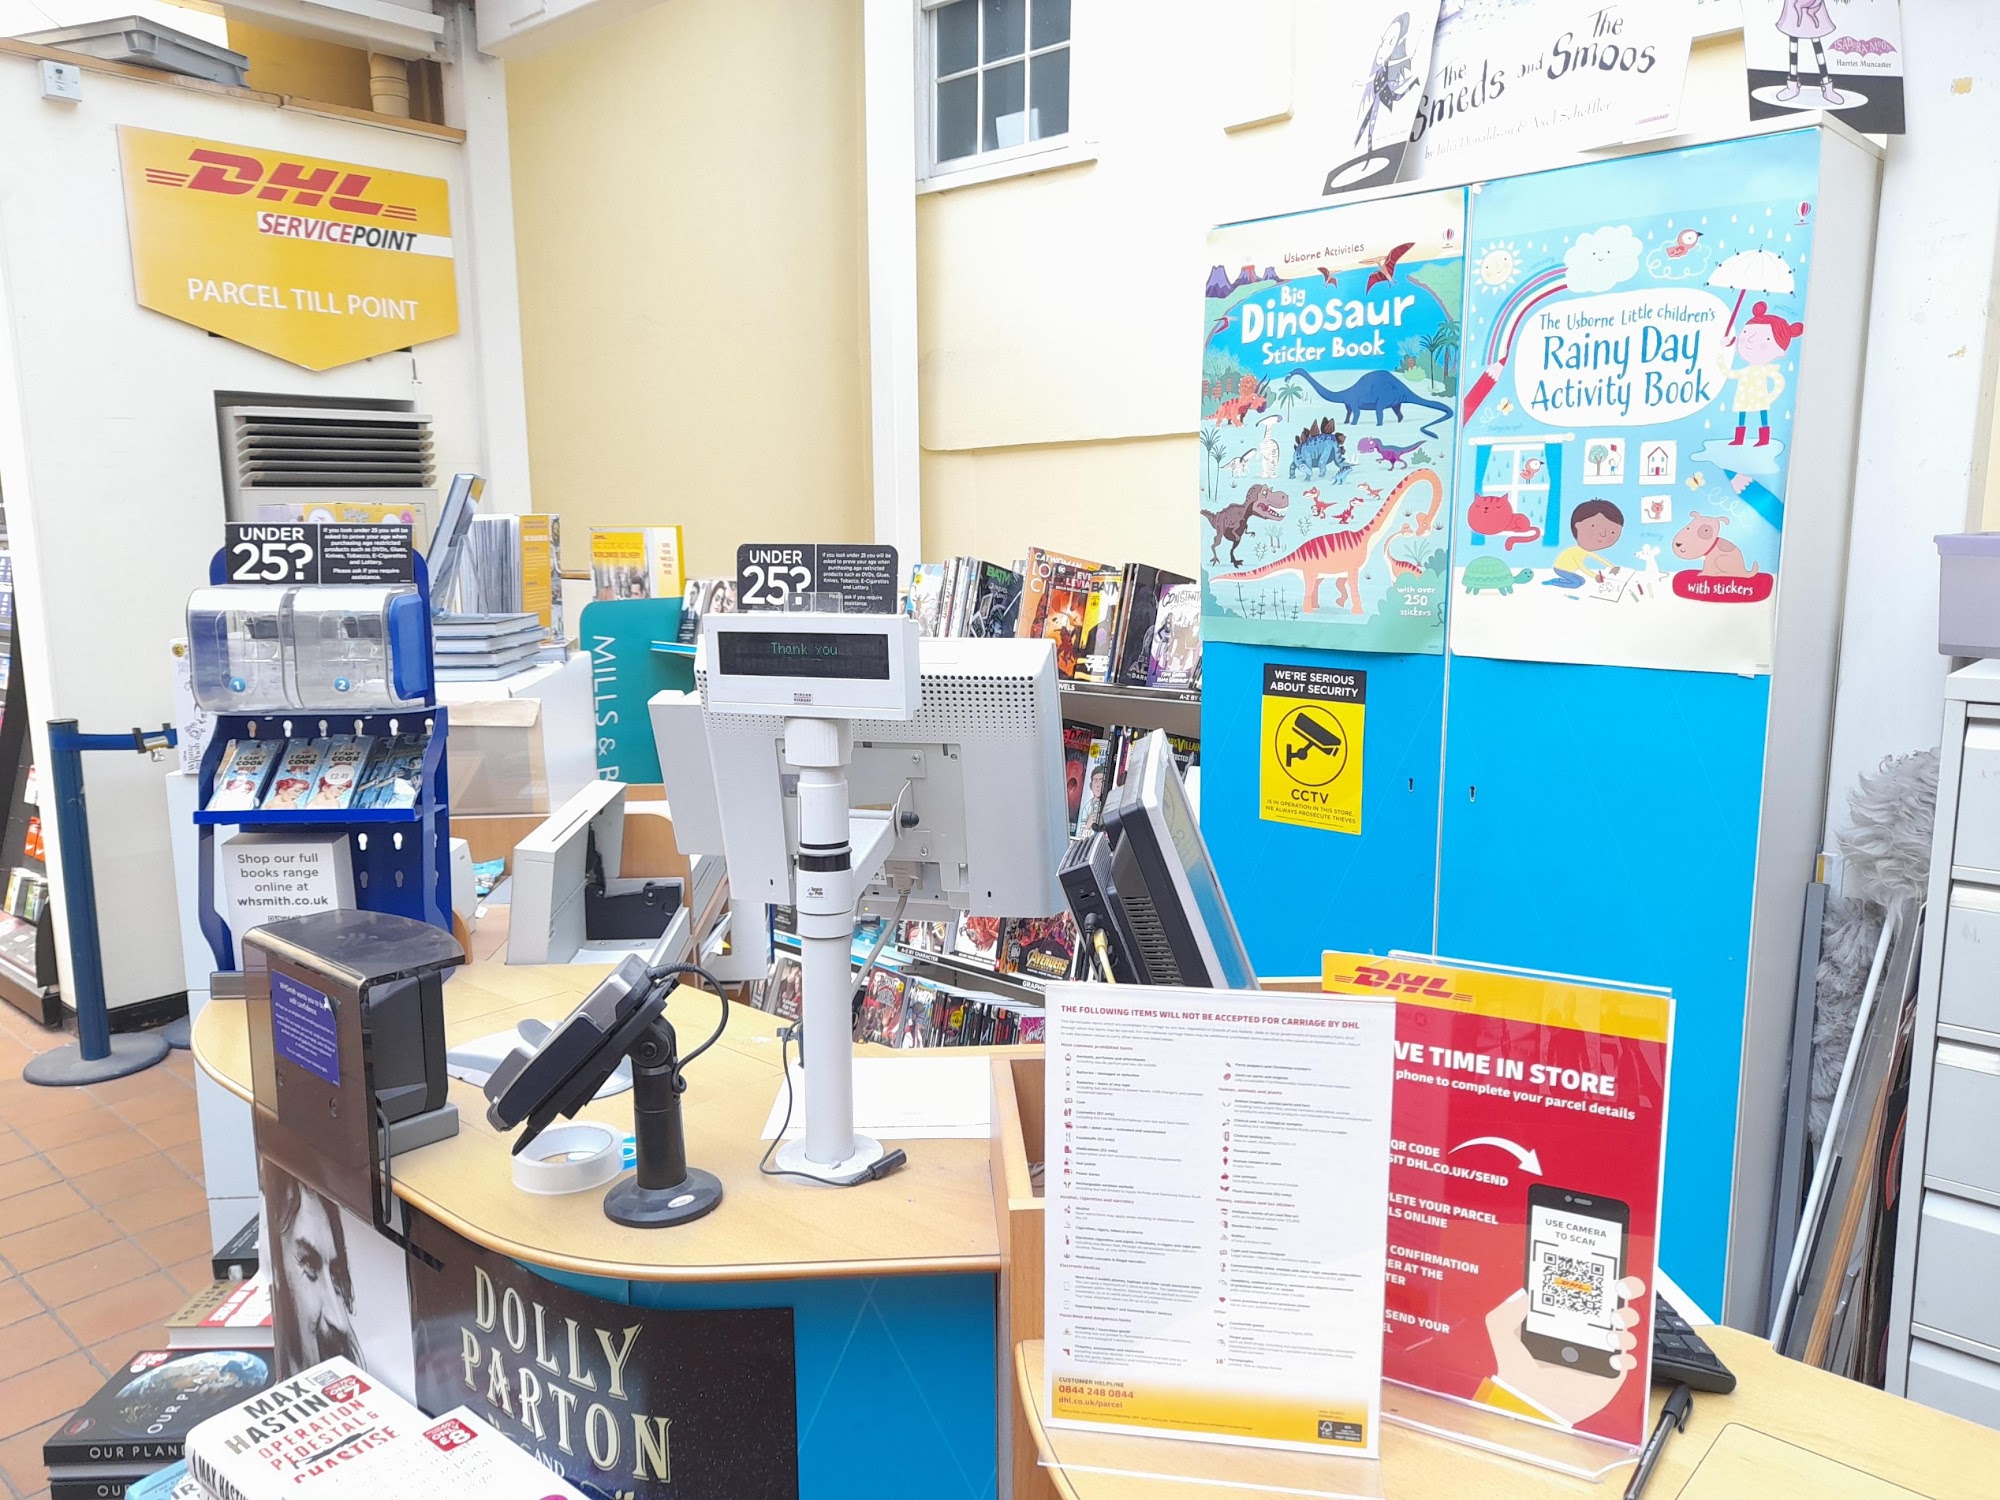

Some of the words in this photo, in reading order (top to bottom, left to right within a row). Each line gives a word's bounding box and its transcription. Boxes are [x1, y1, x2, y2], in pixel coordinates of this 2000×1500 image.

[1587, 4, 1624, 38] The
[1435, 57, 1467, 89] The
[1836, 59, 1859, 68] Harriet
[1860, 60, 1892, 68] Muncaster
[1409, 59, 1506, 143] Smeds
[1517, 52, 1544, 79] and
[1547, 32, 1656, 80] Smoos
[187, 148, 384, 217] DHL
[259, 212, 417, 252] SERVICEPOINT
[1284, 251, 1321, 264] Usborne
[1324, 243, 1365, 257] Activities
[188, 278, 288, 310] PARCEL
[291, 288, 342, 315] TILL
[348, 294, 419, 321] POINT
[1281, 286, 1306, 308] Big
[1241, 295, 1415, 344] Dinosaur
[1540, 313, 1560, 331] The
[1567, 309, 1615, 330] Usborne
[1621, 303, 1653, 324] Little
[1657, 303, 1716, 322] children's
[1262, 337, 1326, 365] Sticker
[1331, 330, 1385, 358] Book
[1543, 333, 1631, 379] Rainy
[1641, 325, 1701, 375] Day
[1531, 379, 1631, 416] Activity
[1644, 368, 1710, 406] Book
[239, 527, 305, 541] UNDER
[232, 542, 314, 581] 25?
[749, 550, 803, 564] UNDER
[1034, 552, 1083, 569] CATWOMAN
[986, 565, 1013, 585] BATM
[742, 565, 812, 606] 25?
[1091, 581, 1120, 595] BATM
[1687, 580, 1710, 594] with
[1712, 580, 1753, 595] stickers
[1162, 590, 1201, 607] CONSTANT
[1404, 594, 1428, 606] 250
[1400, 606, 1432, 616] stickers
[770, 642, 808, 656] Thank
[815, 645, 838, 656] you
[234, 681, 241, 690] 1
[337, 680, 347, 690] 2
[592, 635, 618, 727] MILLS
[1274, 670, 1307, 682] WE'RE
[1309, 673, 1355, 684] SERIOUS
[1269, 682, 1305, 693] ABOUT
[1307, 685, 1359, 697] SECURITY
[598, 737, 616, 756] &
[1280, 801, 1312, 810] OPERATION
[1291, 788, 1329, 804] CCTV
[1275, 807, 1298, 816] ALWAYS
[1298, 810, 1331, 821] PROSECUTE
[1332, 814, 1356, 824] THIEVES
[237, 853, 270, 865] Shop
[274, 855, 295, 863] our
[299, 853, 319, 863] full
[240, 867, 279, 878] books
[283, 869, 319, 880] range
[254, 881, 293, 892] online
[296, 882, 309, 892] at
[237, 895, 329, 907] whsmith.co.uk
[1351, 965, 1454, 999] DHL
[1061, 1005, 1077, 1013] THE
[1079, 1006, 1129, 1016] FOLLOWING
[1131, 1009, 1157, 1018] ITEMS
[1159, 1011, 1180, 1019] WILL
[1182, 1012, 1200, 1020] NOT
[1202, 1013, 1213, 1021] BE
[1215, 1014, 1260, 1024] ACCEPTED
[1262, 1016, 1279, 1024] FOR
[1281, 1017, 1327, 1027] CARRIAGE
[1328, 1020, 1340, 1028] BY
[1342, 1021, 1360, 1029] DHL
[1393, 1040, 1424, 1064] VE
[1429, 1046, 1490, 1075] TIME
[1496, 1057, 1523, 1080] IN
[1529, 1063, 1616, 1097] STORE
[1396, 1069, 1434, 1084] phone
[1436, 1076, 1450, 1087] to
[1451, 1079, 1511, 1099] complete
[1513, 1091, 1543, 1105] your
[1545, 1094, 1586, 1113] parcel
[1589, 1102, 1635, 1121] details
[1390, 1139, 1407, 1151] QR
[1408, 1142, 1440, 1157] CODE
[1406, 1156, 1509, 1188] DHL.CO.UK/SEND
[1404, 1211, 1448, 1228] ONLINE
[1418, 1198, 1451, 1214] YOUR
[1453, 1206, 1499, 1225] PARCEL
[1545, 1218, 1564, 1228] USE
[1566, 1223, 1607, 1238] CAMERA
[1555, 1231, 1568, 1240] TO
[1570, 1234, 1596, 1246] SCAN
[1390, 1244, 1480, 1274] CONFIRMATION
[1404, 1264, 1419, 1274] AT
[1420, 1266, 1444, 1281] THE
[1385, 1309, 1416, 1325] SEND
[1417, 1317, 1450, 1334] YOUR
[474, 1265, 643, 1401] DOLLY
[330, 1378, 357, 1397] ONLY
[337, 1383, 362, 1401] £7
[1058, 1377, 1093, 1385] CUSTOMER
[1094, 1380, 1125, 1388] HELPLINE
[1058, 1384, 1085, 1394] 0844
[1087, 1386, 1106, 1396] 248
[1108, 1389, 1134, 1399] 0844
[147, 1404, 182, 1435] OUR
[176, 1365, 215, 1401] PLAN
[243, 1381, 310, 1419] MAX
[461, 1326, 673, 1484] PARTON
[1058, 1396, 1123, 1408] dhl.co.uk/parcel
[224, 1394, 330, 1455] HASTIN
[258, 1399, 366, 1460] OPERATION
[431, 1423, 460, 1441] ONLY
[270, 1415, 366, 1471] PEDESTAL
[366, 1410, 380, 1420] &
[440, 1429, 472, 1447] £8
[89, 1446, 124, 1459] OUR
[534, 1448, 566, 1478] AND
[198, 1455, 217, 1490] MAX
[219, 1473, 250, 1500] HASTI
